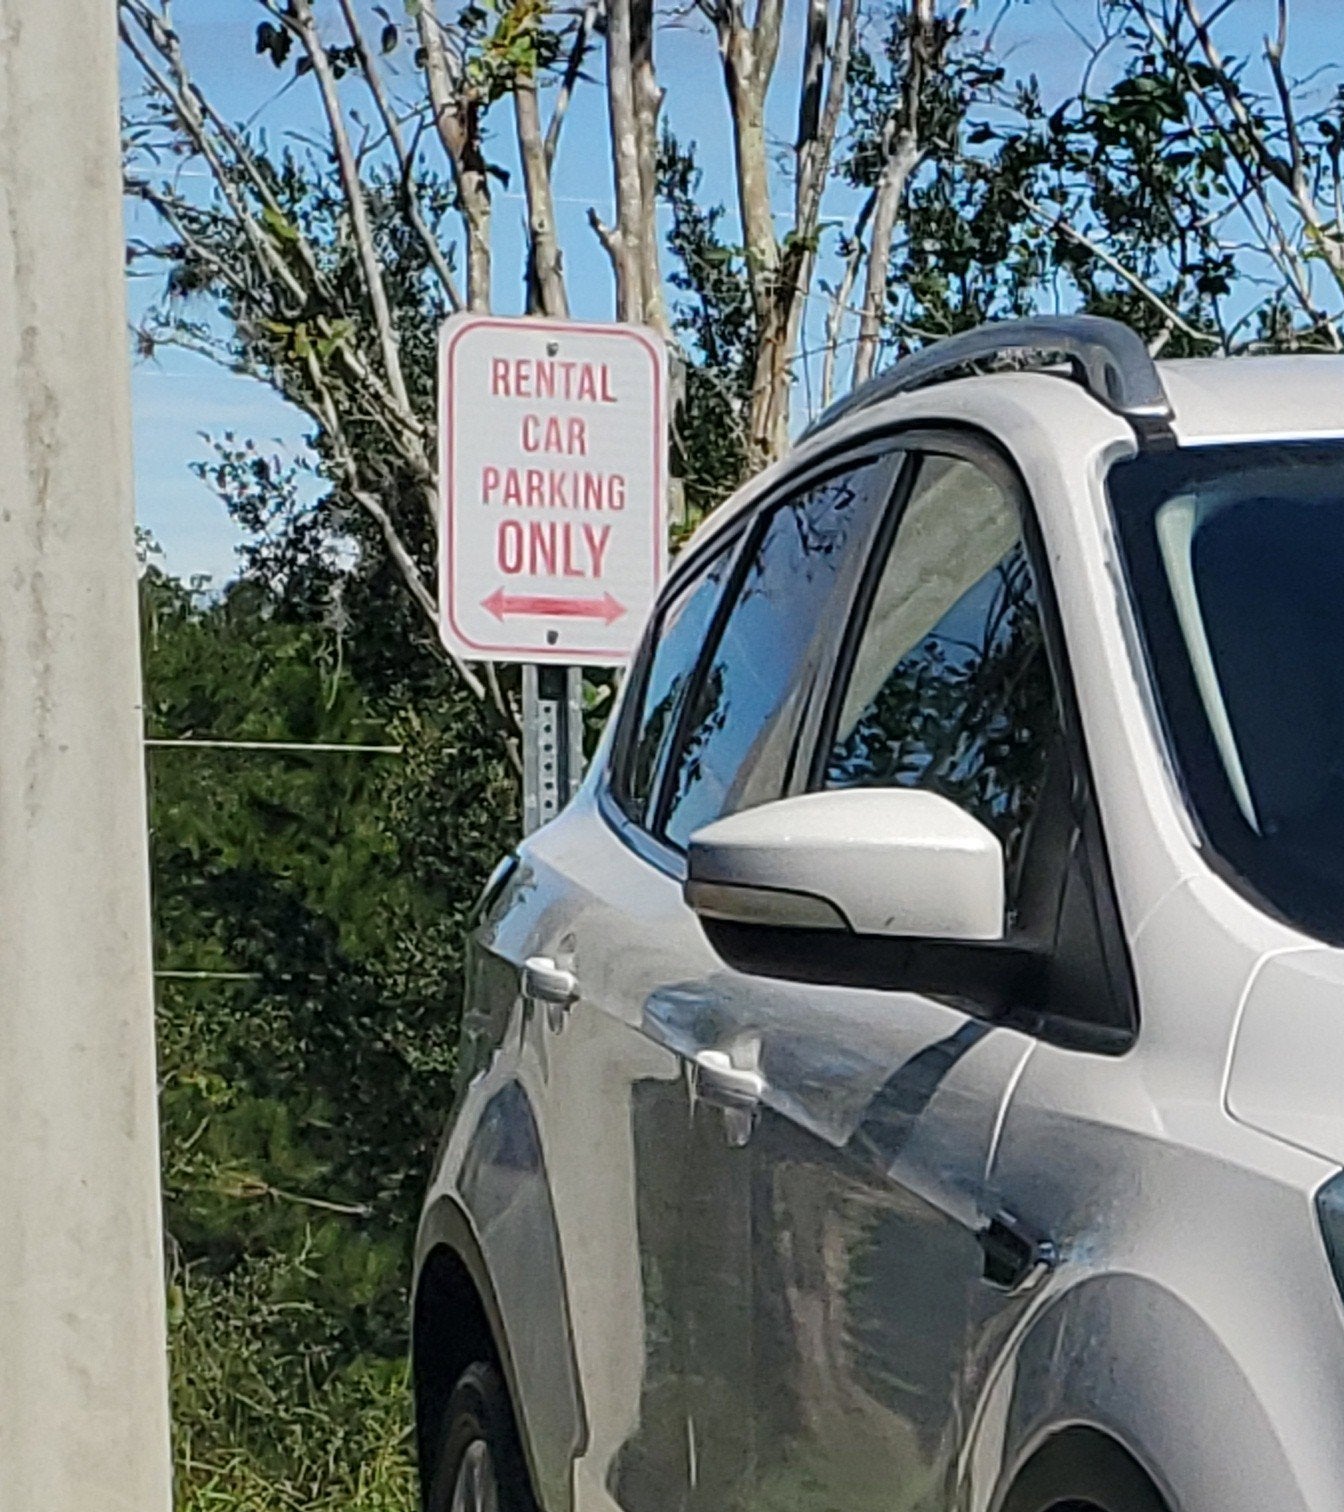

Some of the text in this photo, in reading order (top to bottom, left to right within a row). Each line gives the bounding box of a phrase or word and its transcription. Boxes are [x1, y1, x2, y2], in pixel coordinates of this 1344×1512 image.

[491, 358, 618, 403] RENTAL
[521, 414, 588, 456] CAR
[481, 466, 626, 511] PARKING
[499, 519, 612, 578] ONLY
